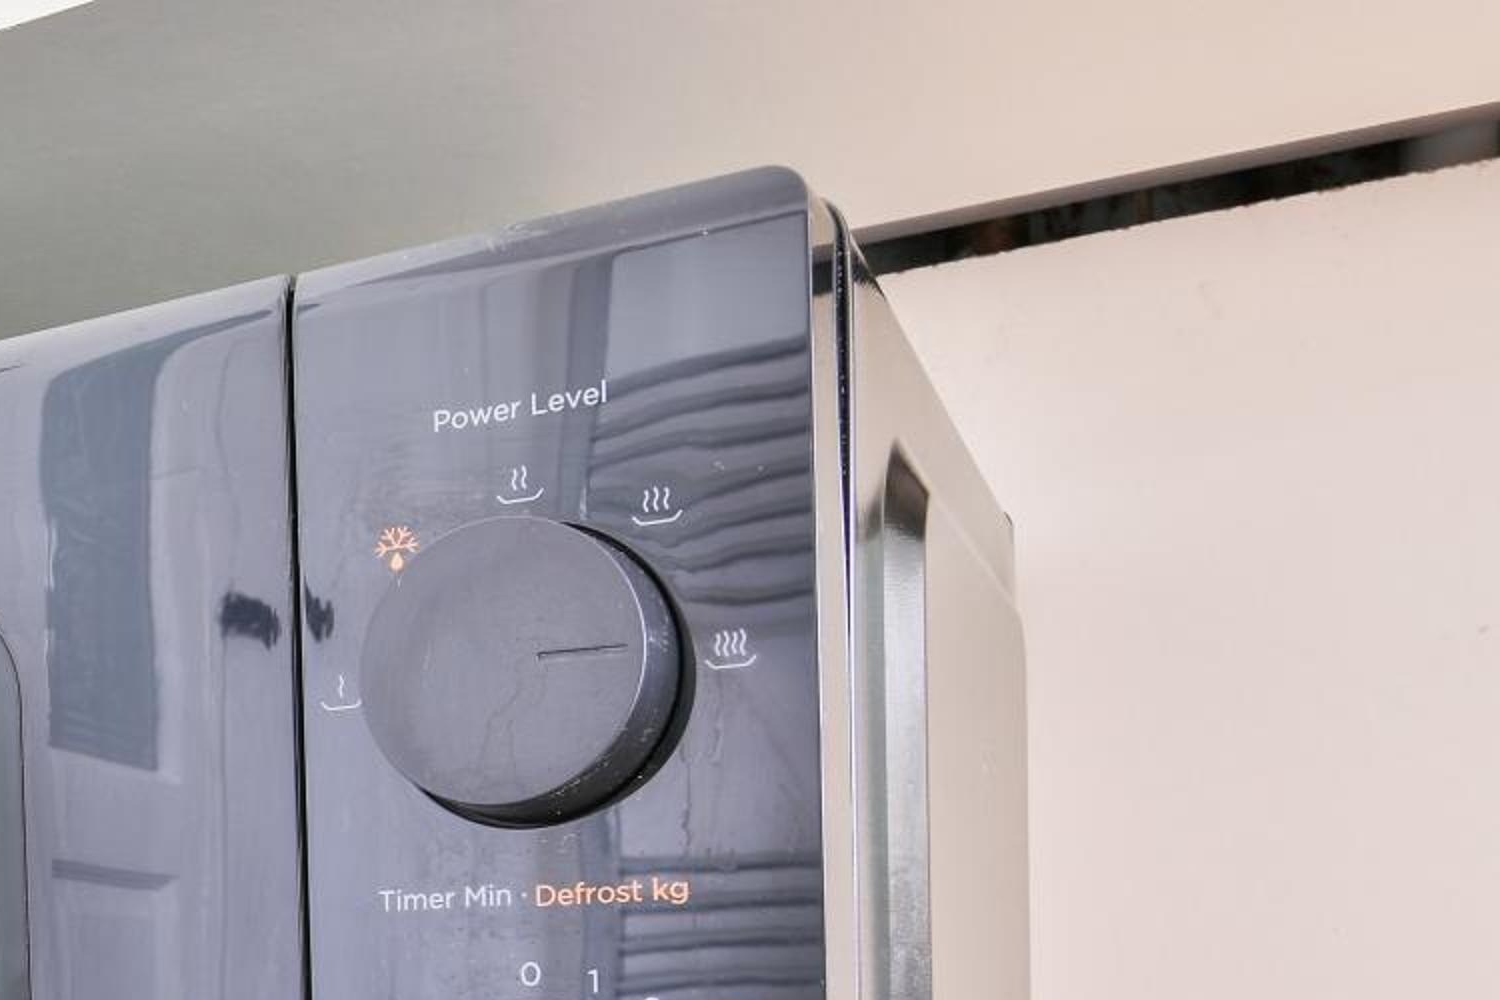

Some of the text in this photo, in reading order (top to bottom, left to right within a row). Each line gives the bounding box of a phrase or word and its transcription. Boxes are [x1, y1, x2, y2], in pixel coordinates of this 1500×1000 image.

[432, 380, 609, 433] Power Level
[378, 877, 690, 913] Timer Min Defrost kg
[520, 961, 541, 987] 0
[587, 968, 600, 994] 1
